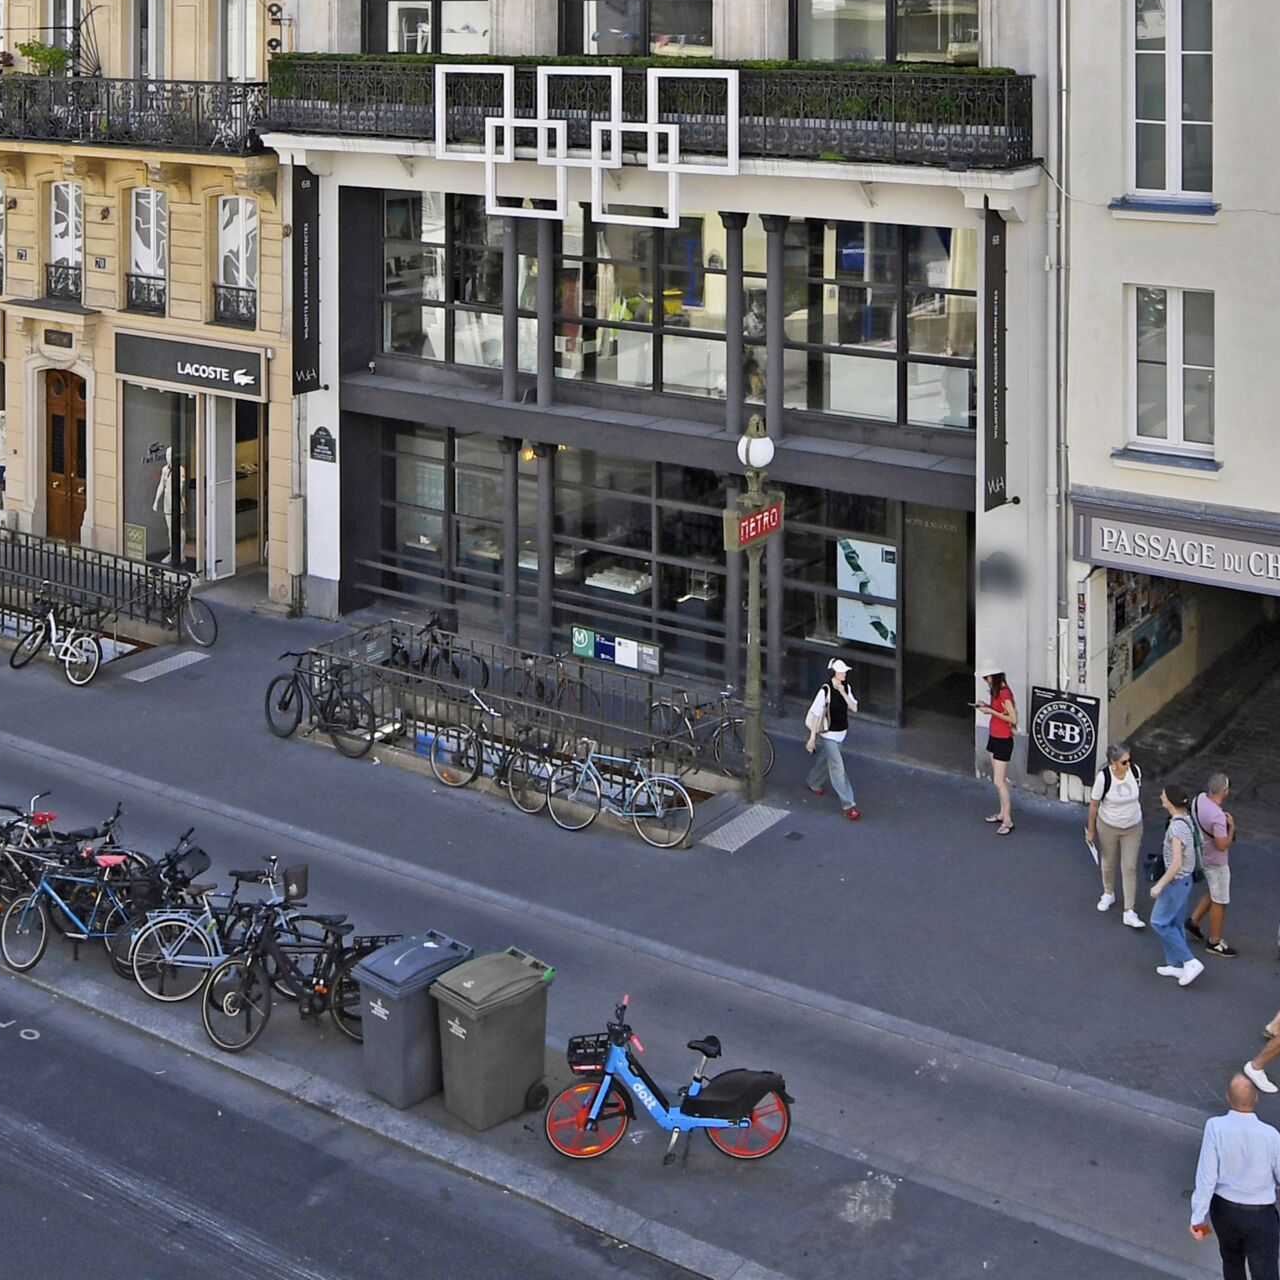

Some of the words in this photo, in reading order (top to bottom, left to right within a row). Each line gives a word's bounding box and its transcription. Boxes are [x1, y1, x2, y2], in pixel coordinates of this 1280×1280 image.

[177, 362, 230, 381] LACOSTE
[740, 508, 778, 541] METRO
[1100, 526, 1217, 570] PASSAGE
[1223, 552, 1246, 574] DU
[1047, 720, 1081, 744] F&B
[632, 1082, 657, 1111] dott
